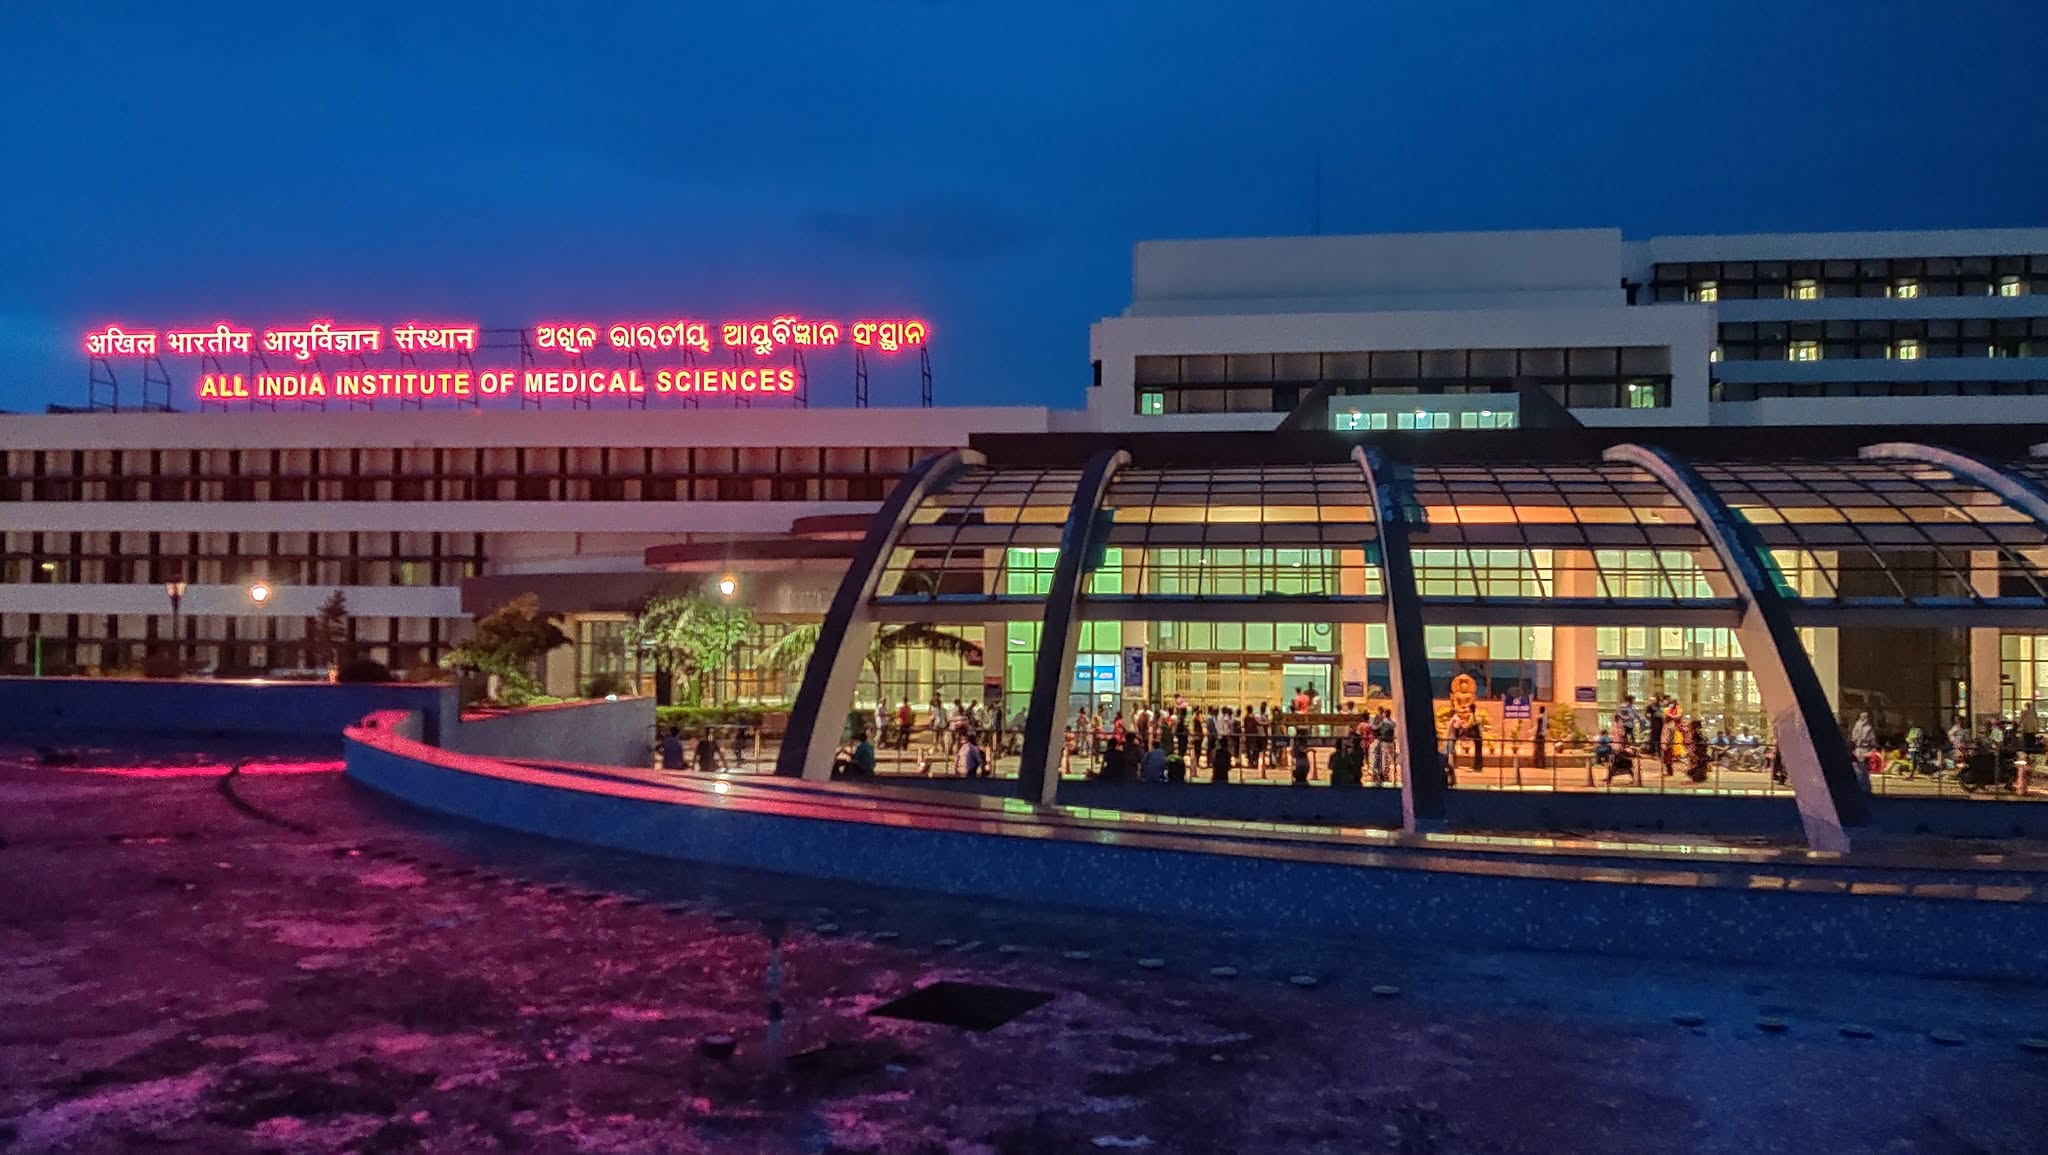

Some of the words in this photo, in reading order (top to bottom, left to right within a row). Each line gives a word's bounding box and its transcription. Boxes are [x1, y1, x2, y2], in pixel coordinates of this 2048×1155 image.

[85, 326, 157, 354] अखिल
[167, 323, 252, 353] भारतीय
[263, 322, 381, 361] आयुर्विज्ञान
[393, 322, 476, 350] संस्थान
[536, 326, 598, 355] ଅଖିଳ
[609, 321, 711, 353] ଭାରତୀୟ
[852, 320, 925, 352] ସଂସ୍ଥାନ
[199, 374, 249, 397] ALL
[258, 373, 326, 397] INDIA
[336, 373, 470, 396] INSTITUTE
[480, 372, 515, 394] OF
[524, 370, 645, 393] MEDICAL
[655, 368, 794, 392] SCIENCES
